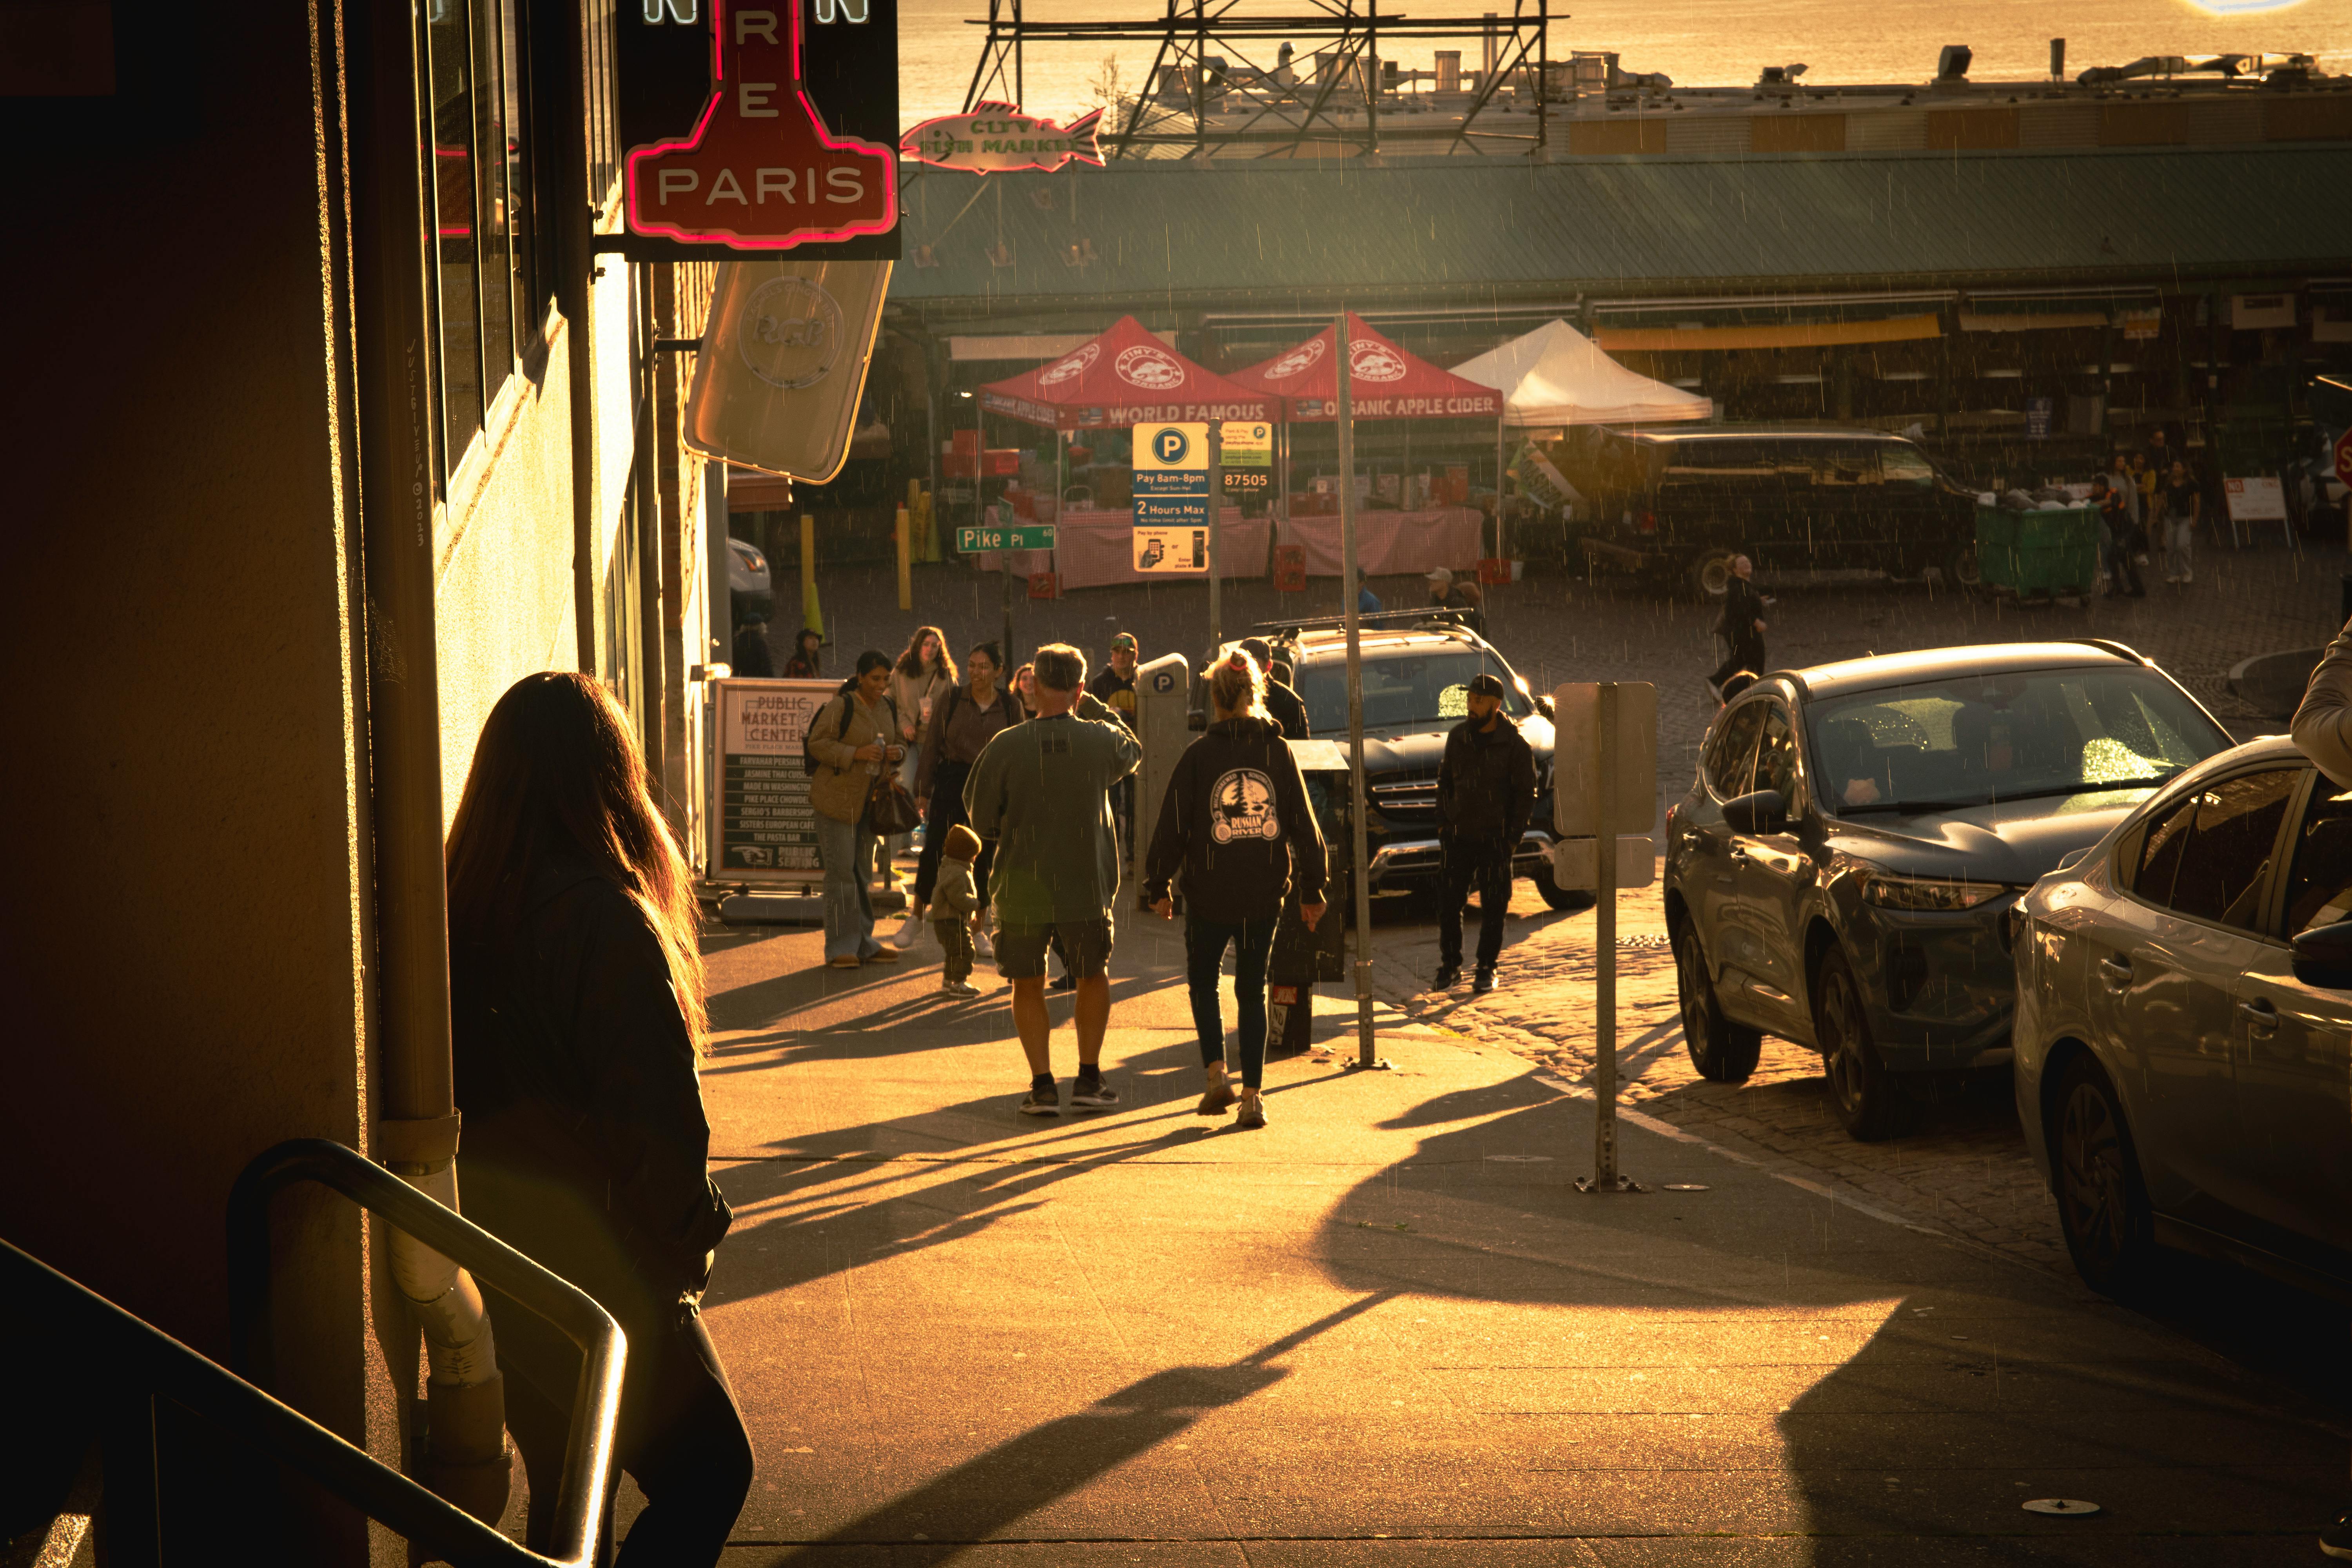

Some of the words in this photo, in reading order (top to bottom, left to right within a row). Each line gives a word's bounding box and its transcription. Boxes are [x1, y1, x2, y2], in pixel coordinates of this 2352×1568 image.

[970, 120, 1033, 134] CITY
[919, 140, 973, 154] FISH
[984, 139, 1080, 154] MARKET
[658, 167, 864, 205] PARIS
[1325, 399, 1392, 416] OGANIC
[1396, 398, 1442, 415] APPLE
[1446, 397, 1494, 414] CIDER
[1109, 405, 1180, 424] WORLD
[1185, 404, 1265, 422] FAMOUS
[1256, 428, 1263, 437] P
[1163, 436, 1181, 457] P
[1136, 474, 1155, 486] Pay
[1157, 474, 1205, 484] 8am-8pm
[1225, 474, 1267, 486] 87505
[1137, 501, 1147, 514] 2
[1149, 506, 1181, 515] Hours
[1184, 506, 1205, 515] Max
[964, 530, 1001, 548] Pike
[1011, 534, 1024, 546] Pl
[1158, 676, 1170, 690] P
[758, 696, 807, 710] PUBLIC
[742, 711, 797, 726] MARKET
[740, 757, 773, 766] FARVAHAR
[773, 757, 801, 766] PERSIAN
[744, 770, 771, 779] JASMINE
[772, 770, 787, 779] THAI
[743, 782, 762, 791] MADE
[762, 782, 770, 791] IN
[744, 795, 759, 803] PIKE
[760, 795, 779, 803] PLACE
[741, 807, 770, 816] SERGIO'S
[772, 808, 814, 817] BARBERSHOP
[739, 820, 764, 829] SISTERS
[765, 820, 799, 829] EUROPEAN
[1231, 816, 1262, 829] RUSSIAN
[753, 833, 766, 842] THE
[767, 833, 786, 842] PASTA
[787, 833, 800, 842] BAR
[778, 846, 817, 857] PUBLIC
